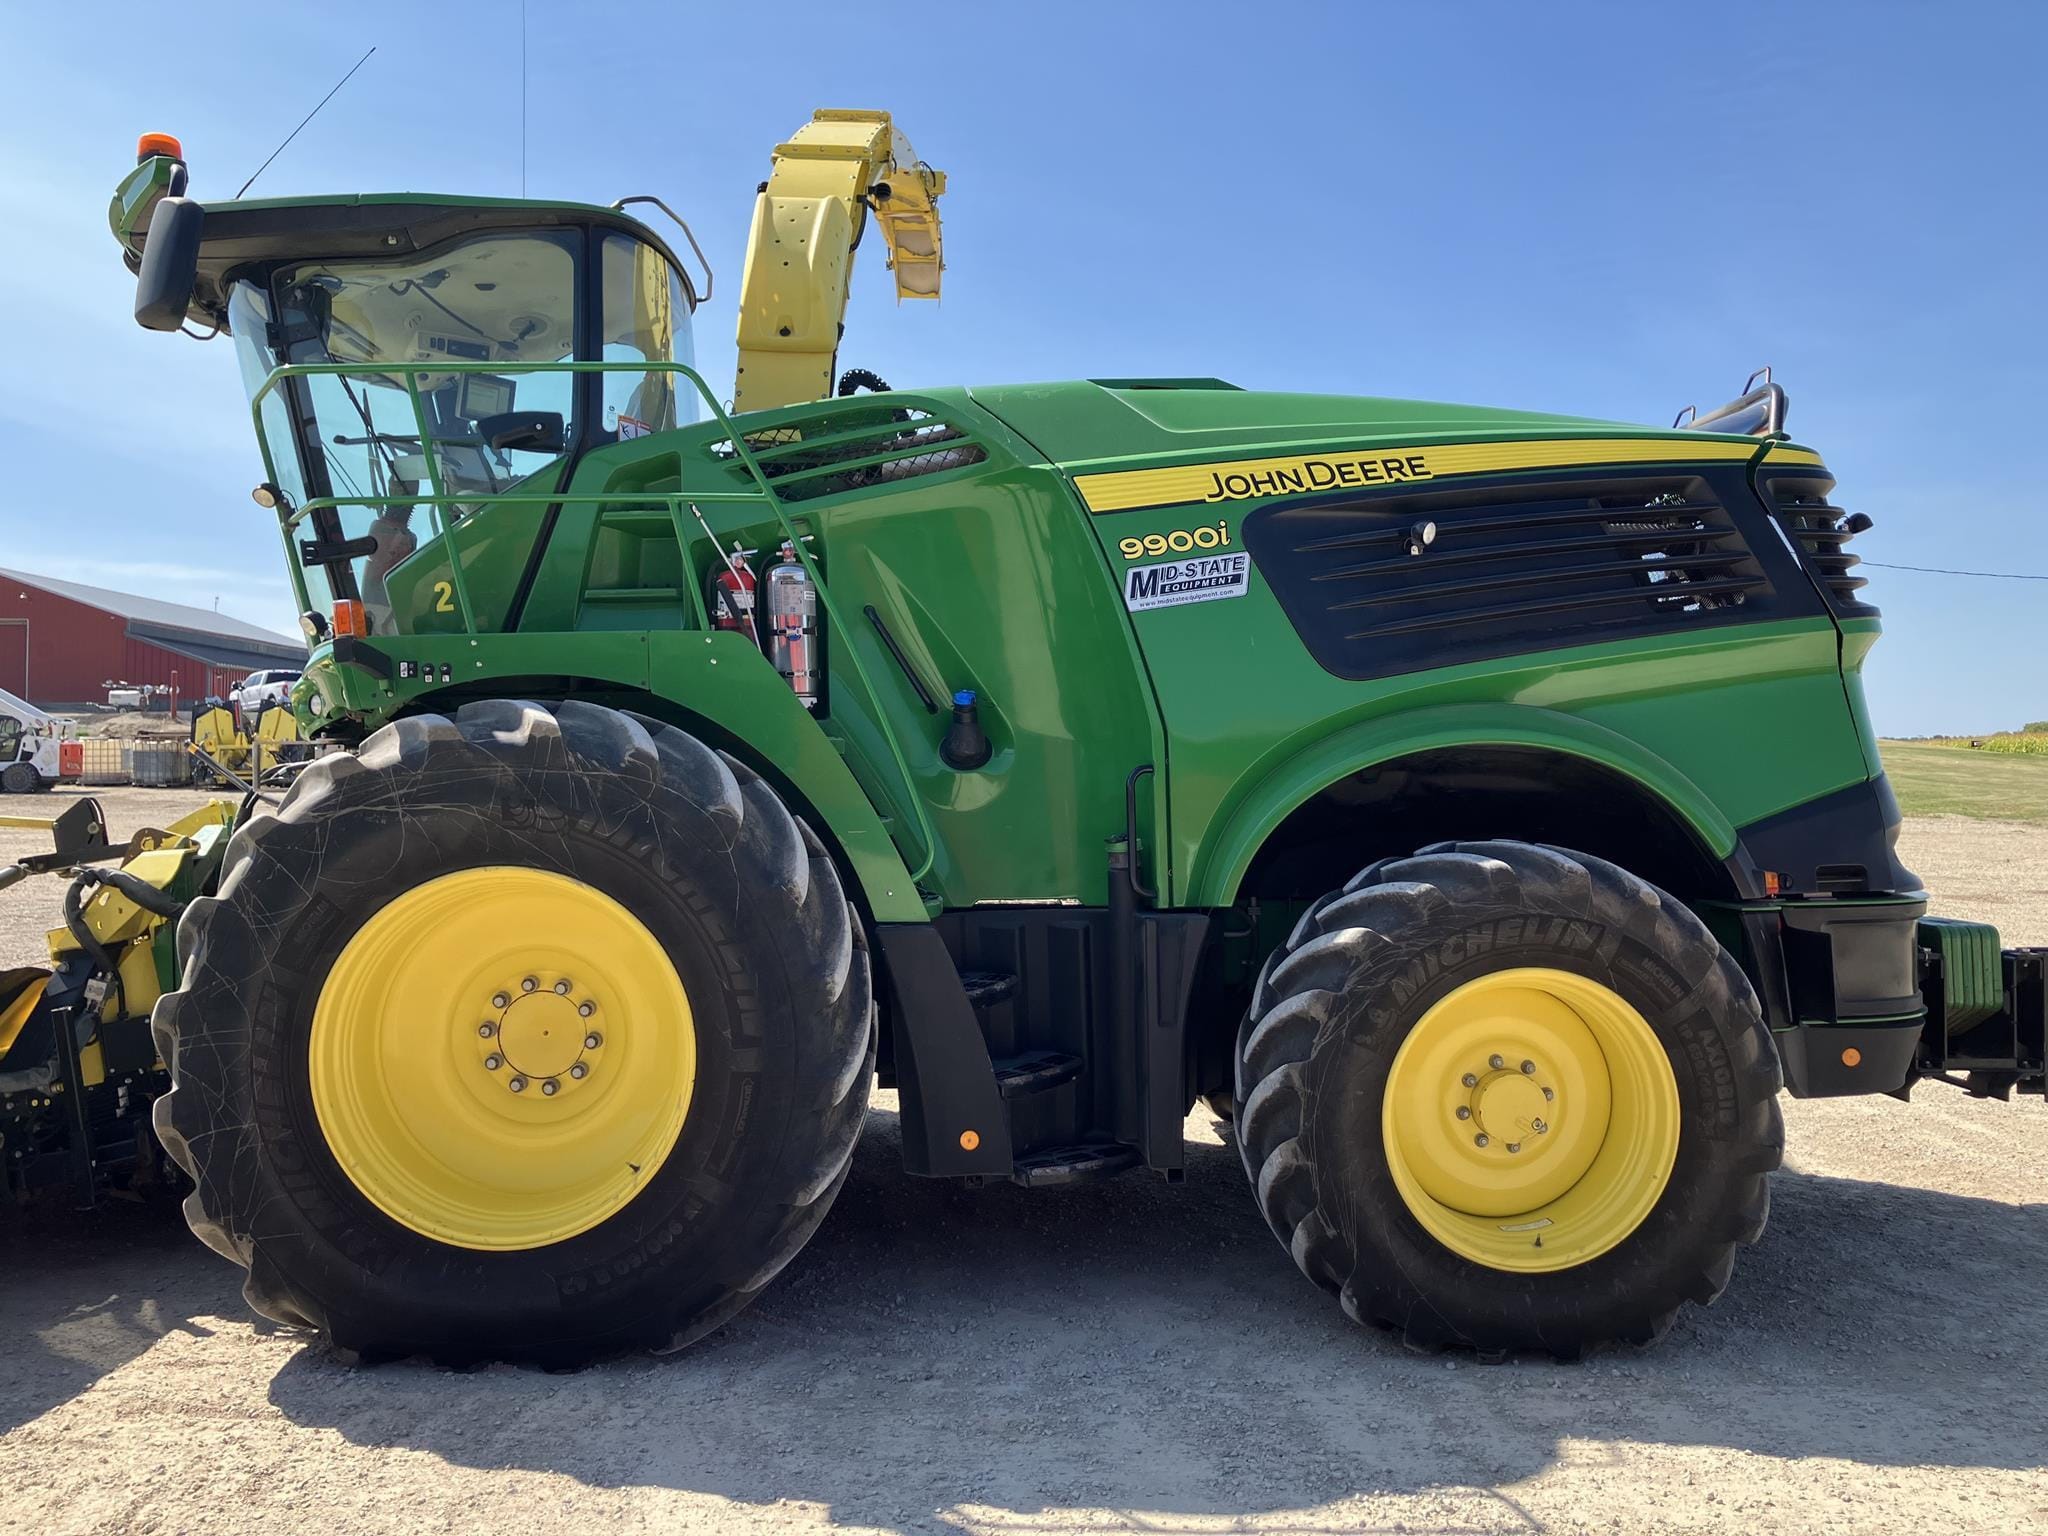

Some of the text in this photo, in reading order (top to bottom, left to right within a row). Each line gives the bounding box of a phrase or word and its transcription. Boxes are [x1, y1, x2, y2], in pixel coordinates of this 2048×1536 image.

[1207, 456, 1431, 501] JOHN DEERE
[1118, 519, 1233, 561] 9900i
[433, 580, 456, 613] 2
[1130, 555, 1246, 601] MID-STATE
[1164, 575, 1234, 593] EQUIPMENT
[1392, 917, 1607, 1003] MICHELIN
[1639, 956, 1685, 999] MICHELIN
